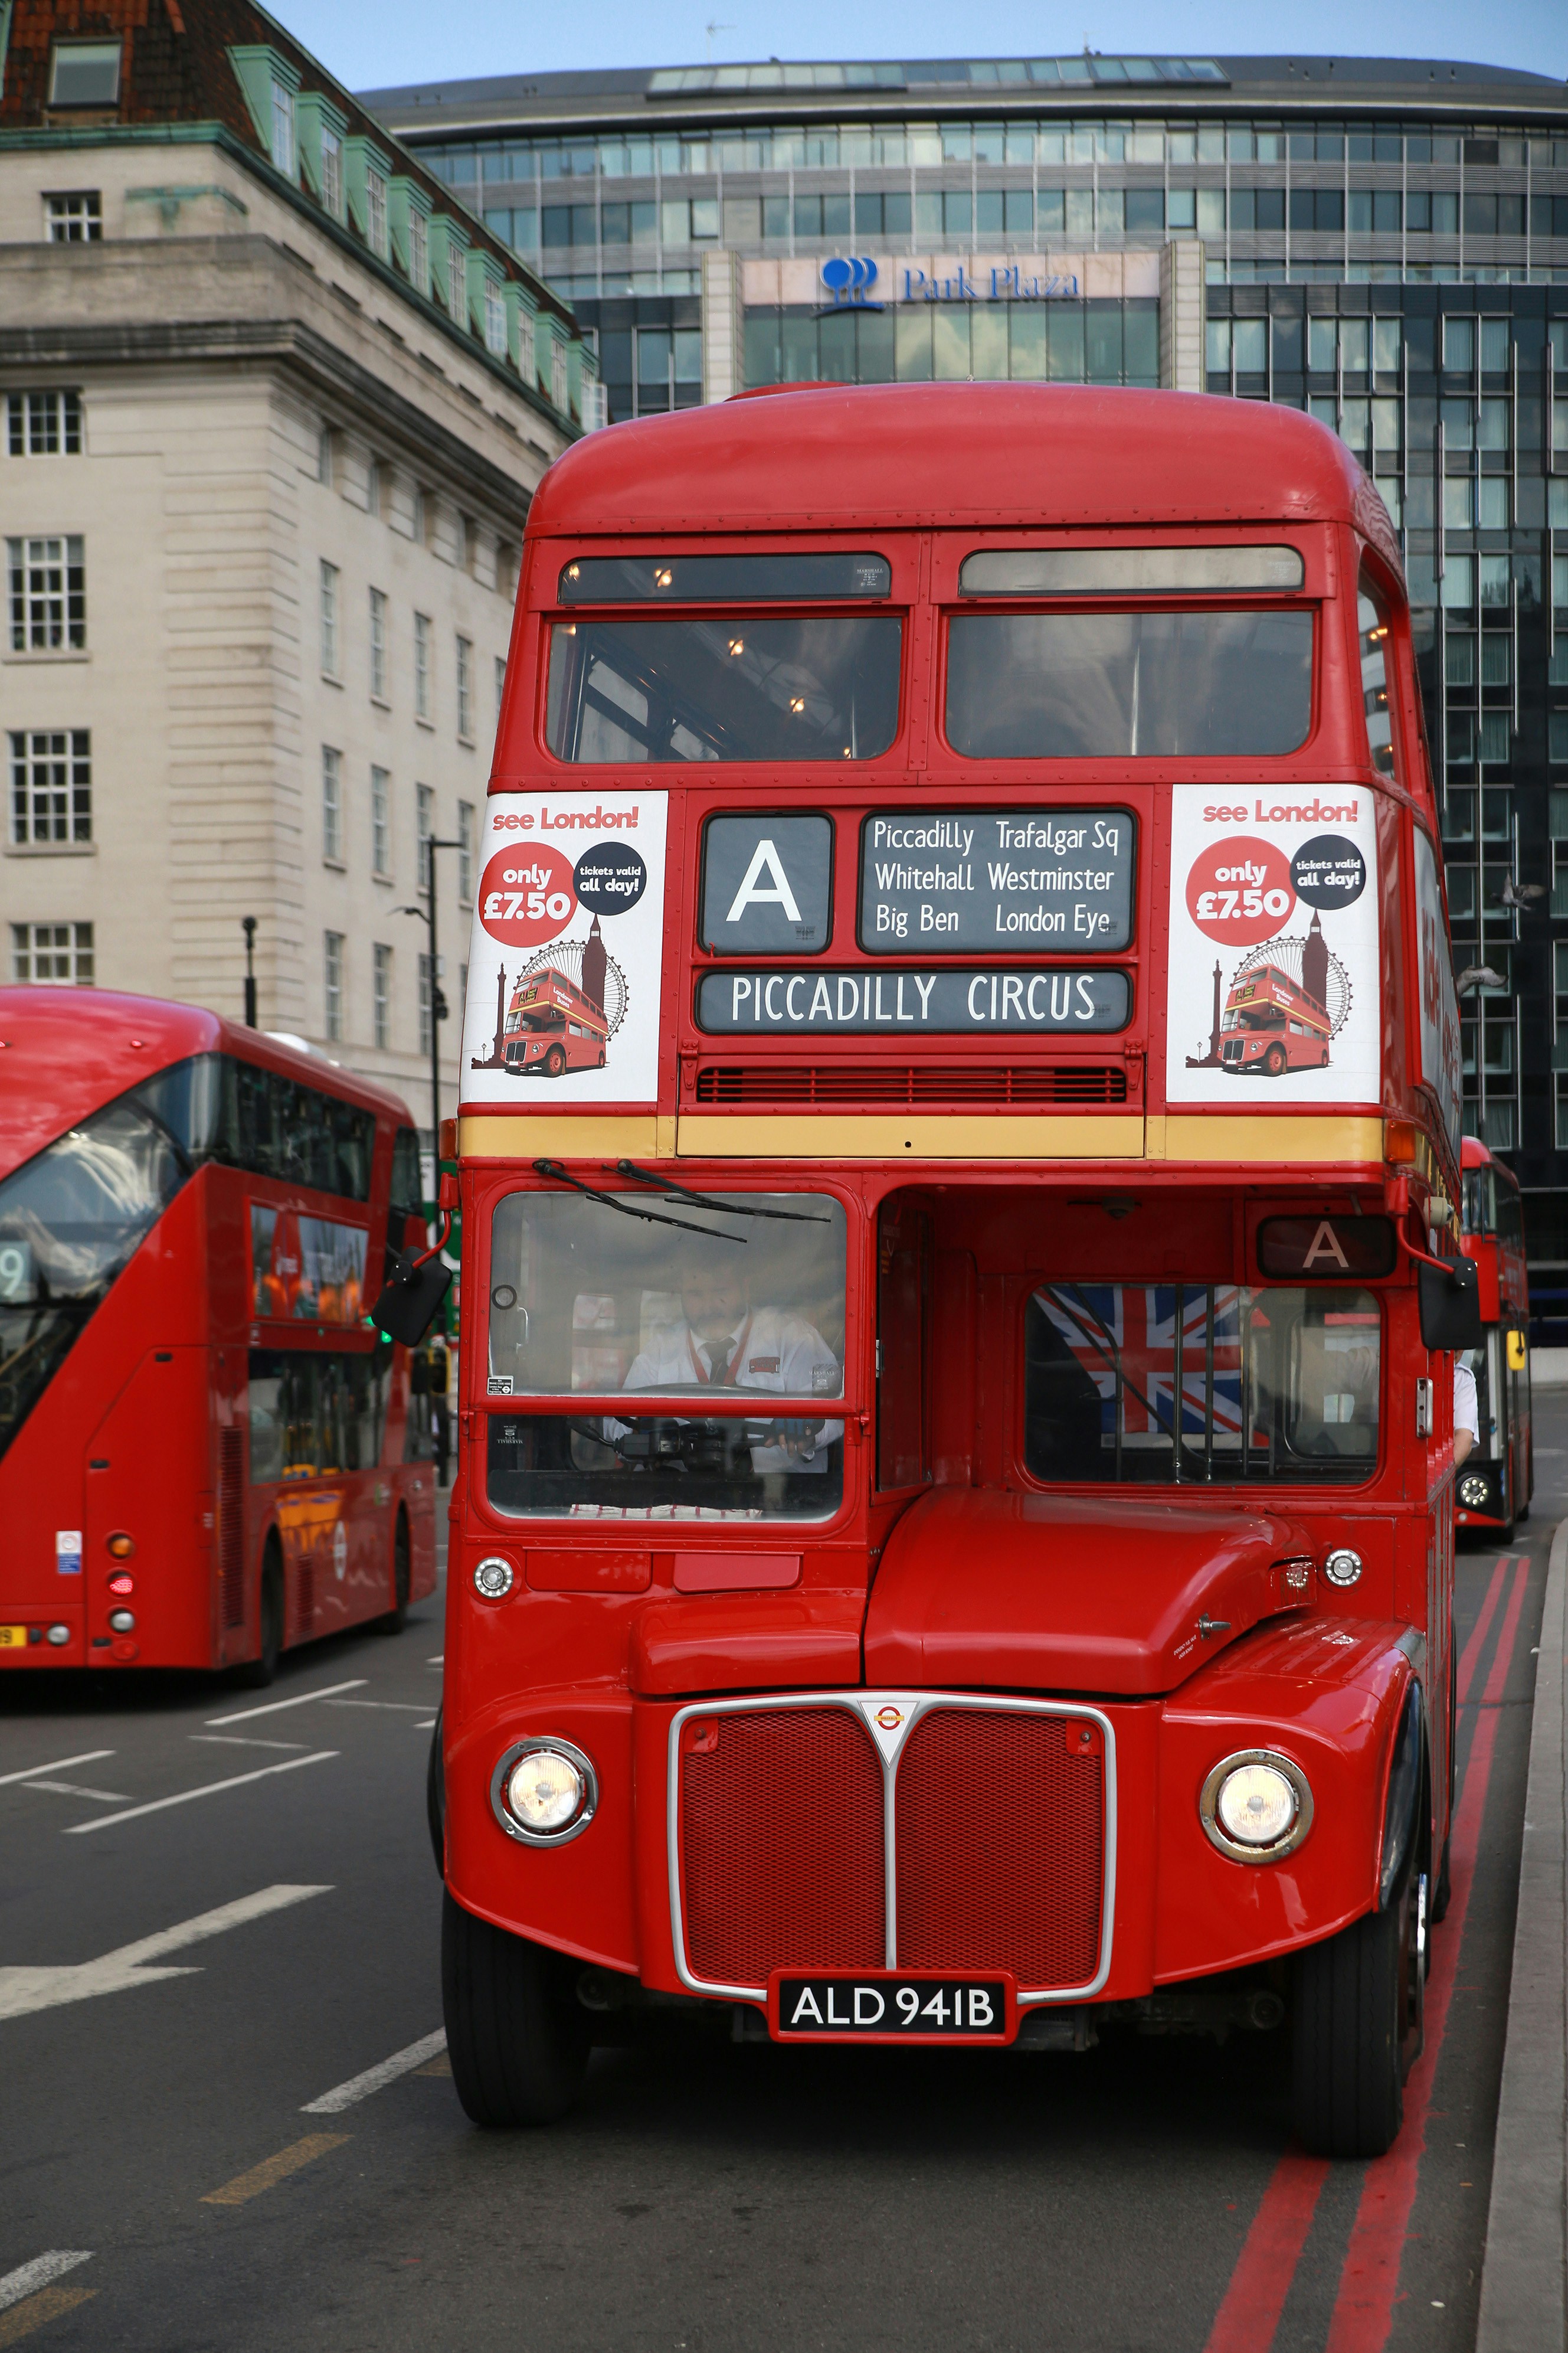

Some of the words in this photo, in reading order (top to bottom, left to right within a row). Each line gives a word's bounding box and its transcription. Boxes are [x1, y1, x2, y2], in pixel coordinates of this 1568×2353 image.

[904, 266, 977, 300] Park
[990, 263, 1079, 299] Plaza
[492, 813, 535, 830] see
[540, 806, 639, 829] London!
[1203, 805, 1248, 822] see
[1255, 798, 1358, 822] London!
[874, 820, 974, 857] Piccadilly
[996, 821, 1087, 856] Trafalgar
[1091, 821, 1118, 856] Sq
[502, 863, 552, 890] only
[580, 865, 614, 876] tickets
[616, 865, 641, 876] valid
[875, 862, 974, 891] Whitehall
[987, 862, 1115, 891] Westminster
[1215, 860, 1268, 887] only
[1295, 860, 1333, 870] tickets
[1334, 858, 1361, 870] valid
[579, 878, 601, 893] all
[605, 877, 640, 897] day!
[725, 839, 802, 921] A
[1297, 872, 1320, 887] all
[1324, 871, 1360, 890] day!
[483, 891, 571, 920] £7.50
[1196, 888, 1290, 920] £7.50
[876, 904, 908, 938] Big
[920, 904, 959, 932] Ben
[996, 904, 1065, 932] London
[1074, 904, 1110, 939] Eye
[553, 986, 573, 1004] Londoner
[557, 995, 570, 1008] Buses
[732, 976, 937, 1021] PICCADILLY
[968, 975, 1095, 1021] CIRCUS
[1272, 983, 1294, 1001] Londoner
[1276, 994, 1290, 1006] Buses
[1302, 1220, 1350, 1269] A
[0, 1249, 23, 1296] 9
[791, 1987, 885, 2024] ALD
[896, 1988, 994, 2026] 941B
